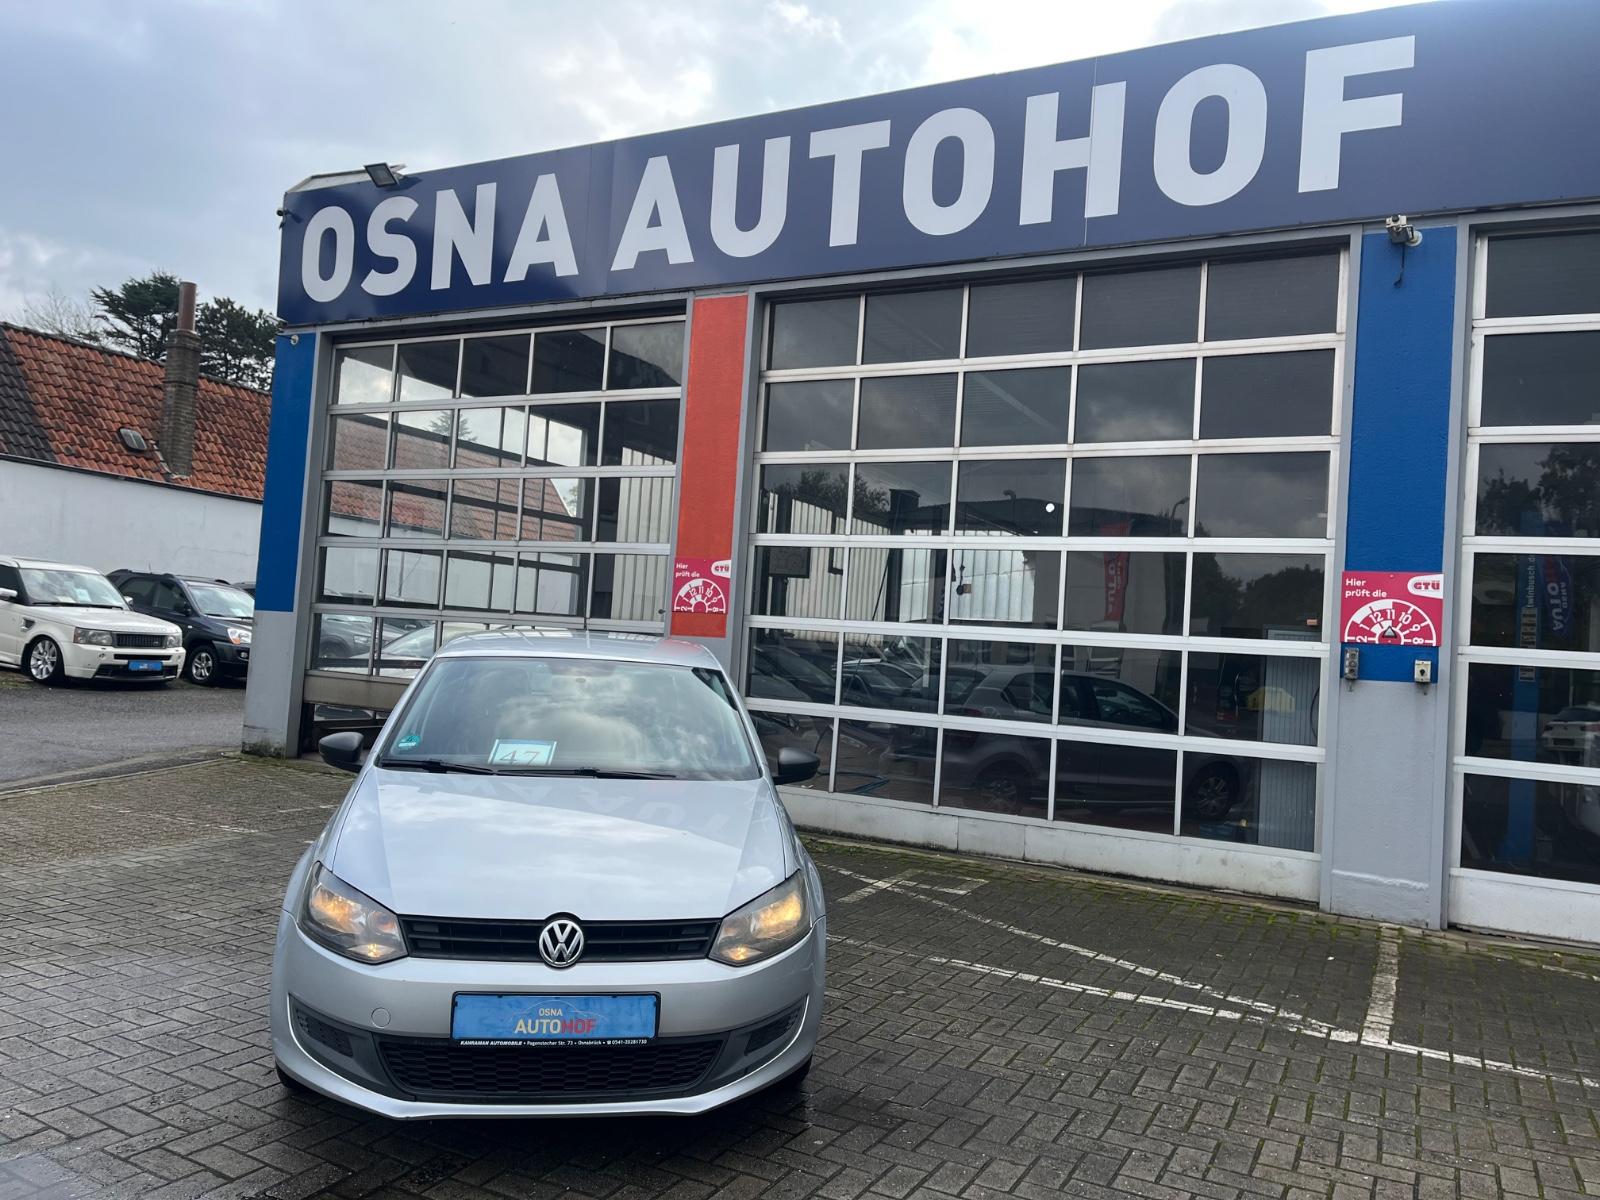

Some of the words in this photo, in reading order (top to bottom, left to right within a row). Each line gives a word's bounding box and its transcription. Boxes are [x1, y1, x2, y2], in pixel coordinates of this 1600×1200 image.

[302, 173, 579, 303] OSNA
[610, 35, 1416, 272] AUTOHOF
[1345, 578, 1366, 587] Hier
[1413, 580, 1441, 590] GTÜ
[1345, 589, 1370, 598] prüft
[1369, 611, 1384, 623] 12
[1386, 609, 1395, 619] 11
[1399, 612, 1412, 625] 10
[1356, 635, 1368, 643] 2
[539, 920, 584, 967] VW
[539, 1008, 563, 1017] OSNA
[514, 1018, 598, 1035] AUTOHOF
